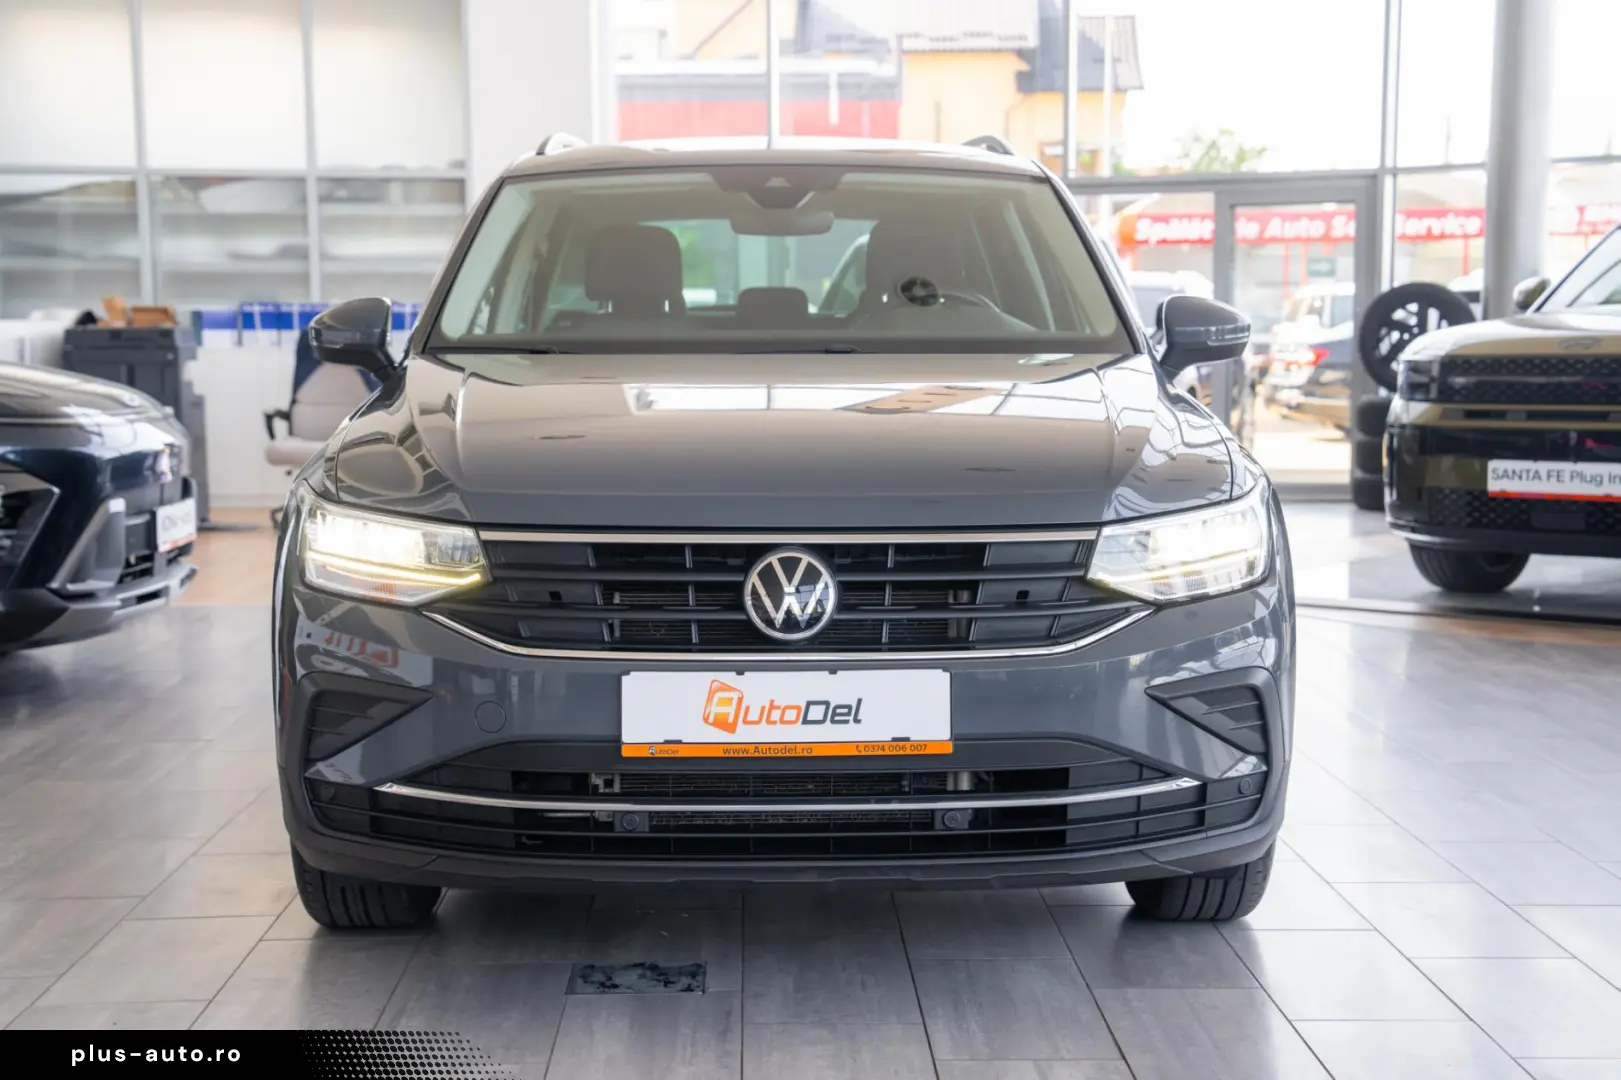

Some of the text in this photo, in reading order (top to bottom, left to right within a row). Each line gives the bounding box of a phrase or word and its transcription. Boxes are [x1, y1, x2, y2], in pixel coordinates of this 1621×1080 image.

[1263, 215, 1326, 239] Auto
[1491, 467, 1542, 481] SANTA
[1546, 469, 1566, 482] FE
[1569, 470, 1604, 486] Plug
[704, 685, 862, 730] AutoDel
[722, 745, 813, 756] www.Autodel.ro
[863, 743, 928, 753] 0374 006 007
